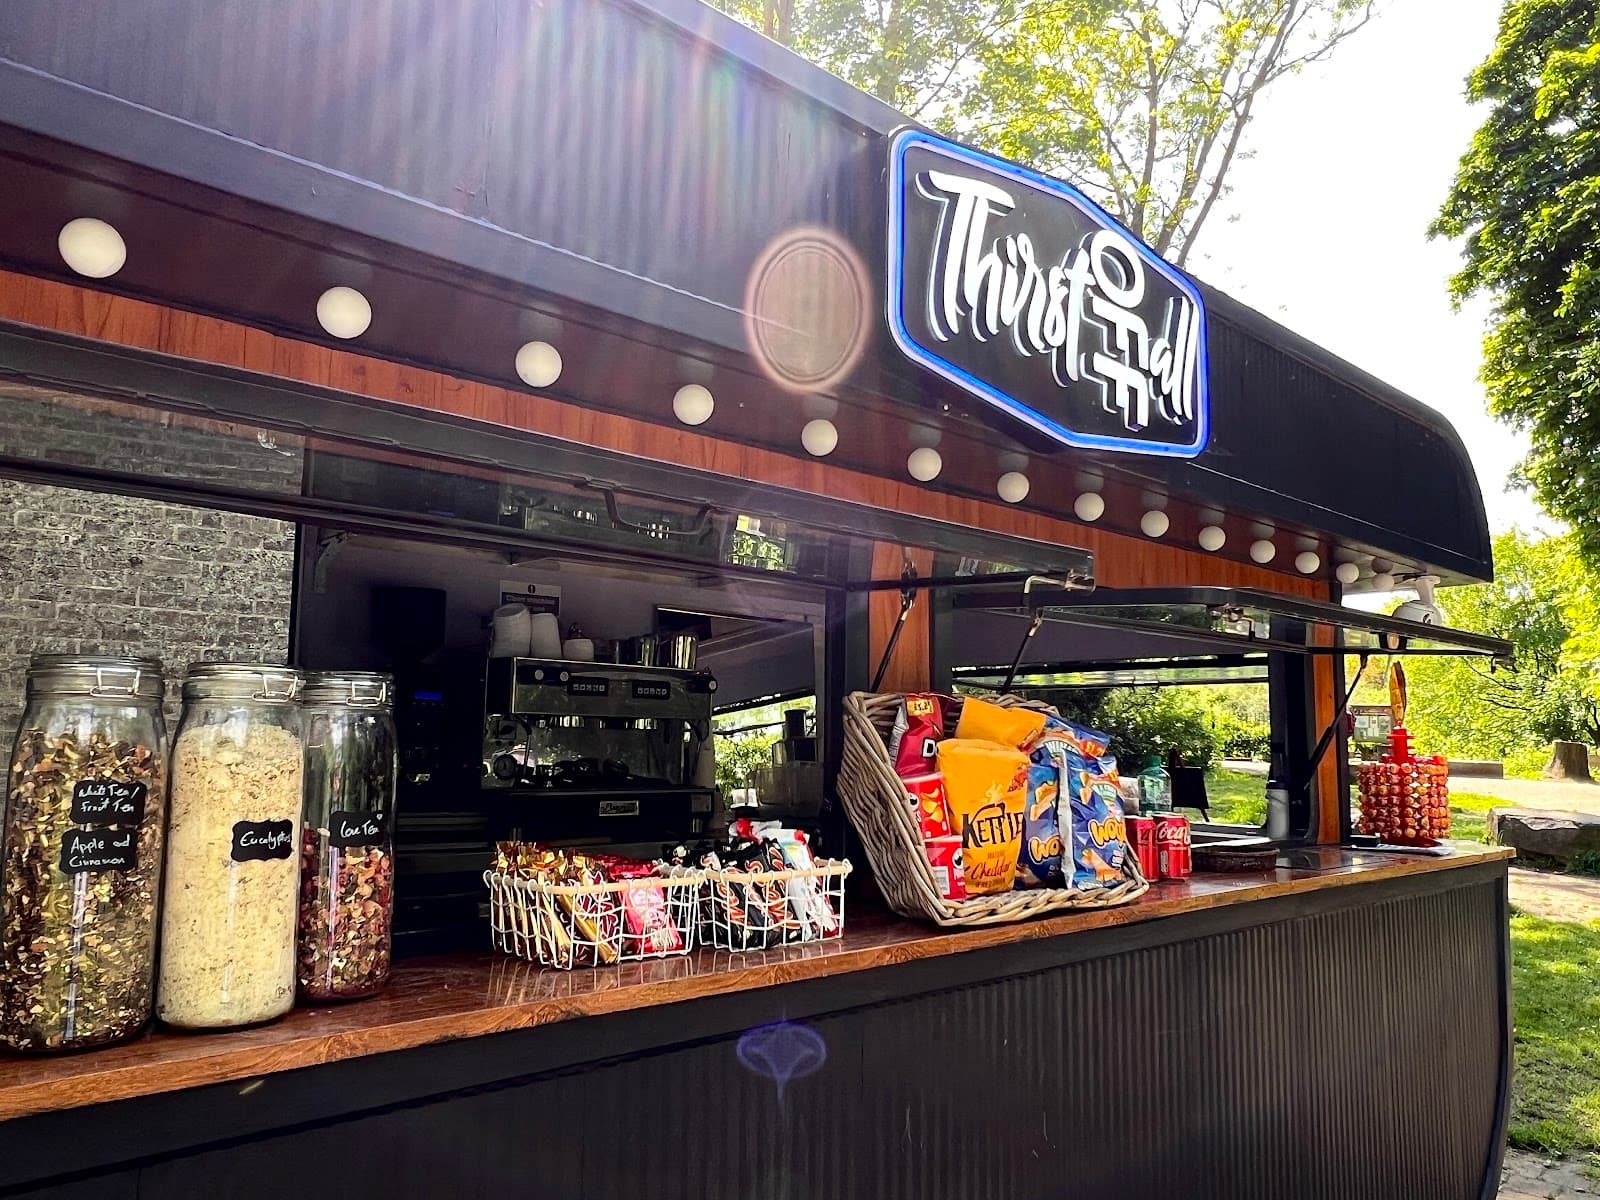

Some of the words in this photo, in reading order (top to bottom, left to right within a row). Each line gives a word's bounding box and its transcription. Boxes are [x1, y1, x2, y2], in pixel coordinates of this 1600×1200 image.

[917, 169, 1095, 386] Thirst
[112, 797, 135, 813] Tea
[361, 819, 380, 836] Tea
[70, 836, 105, 854] Apple
